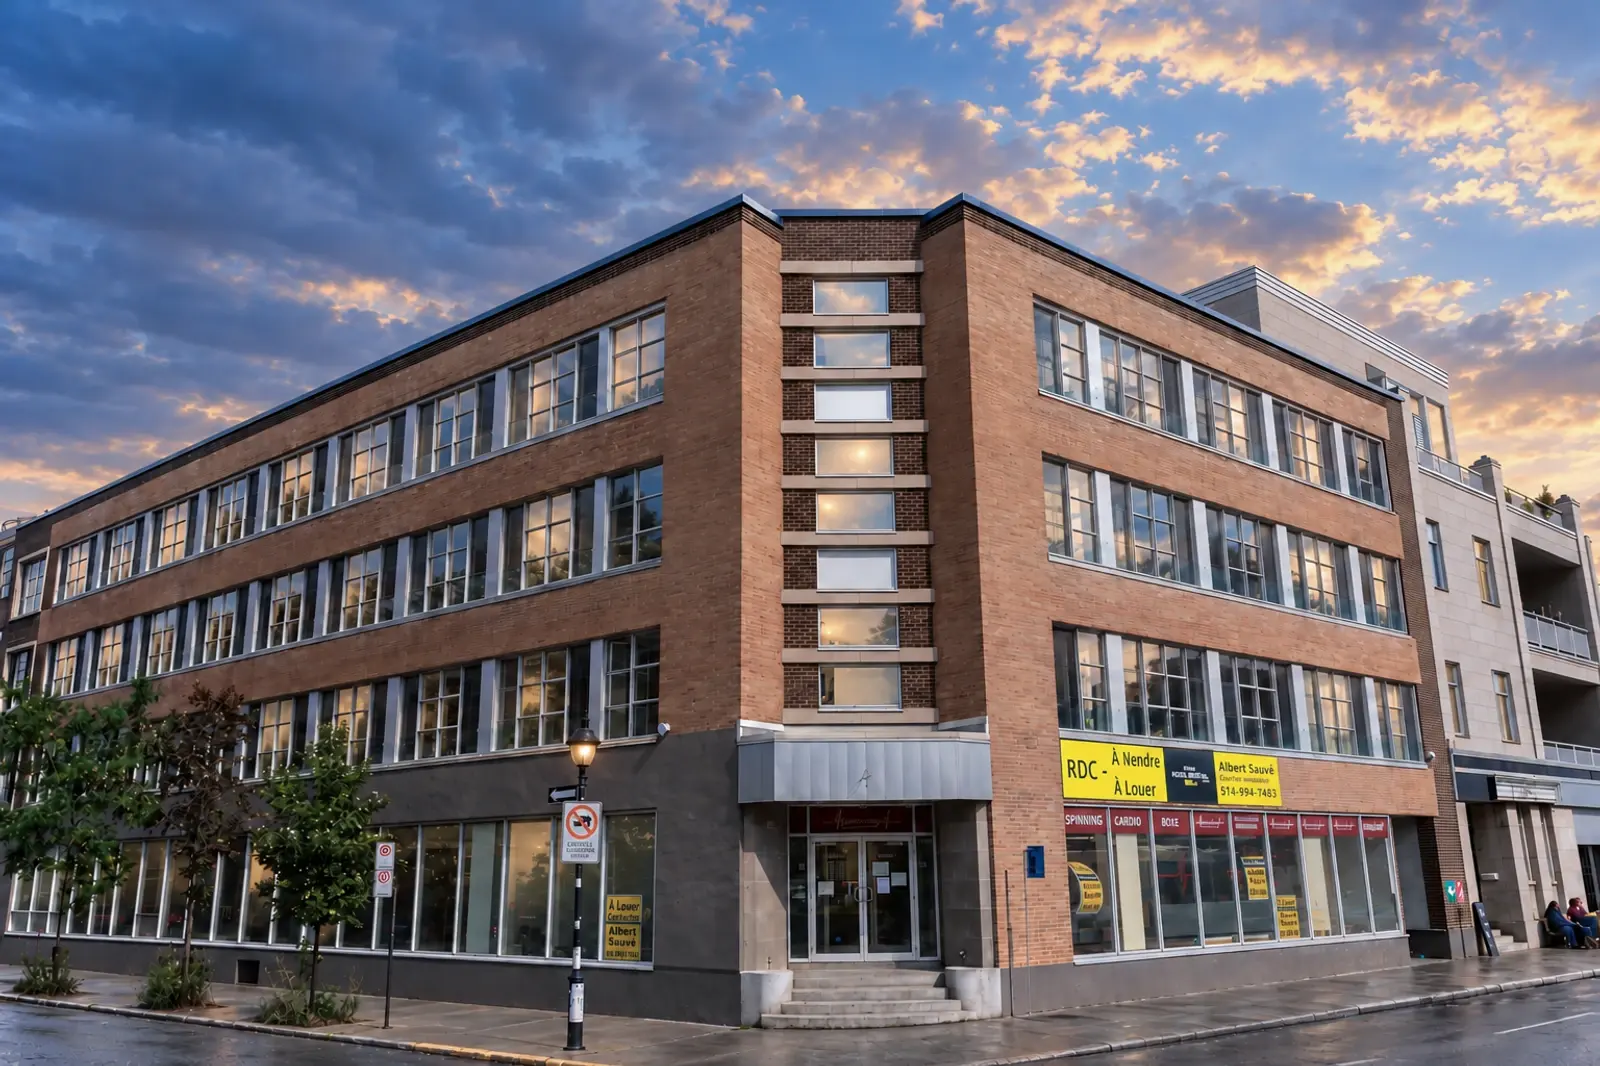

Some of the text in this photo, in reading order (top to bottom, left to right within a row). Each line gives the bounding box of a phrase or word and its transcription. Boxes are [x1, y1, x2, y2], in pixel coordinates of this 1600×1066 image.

[1112, 747, 1120, 766] À
[1067, 759, 1098, 780] RDC
[1219, 761, 1247, 773] Albert
[1114, 776, 1156, 796] À Louer
[1065, 814, 1103, 826] SPINNING
[1114, 816, 1142, 827] CARDIO
[616, 900, 640, 911] Louer
[609, 926, 637, 936] Albert
